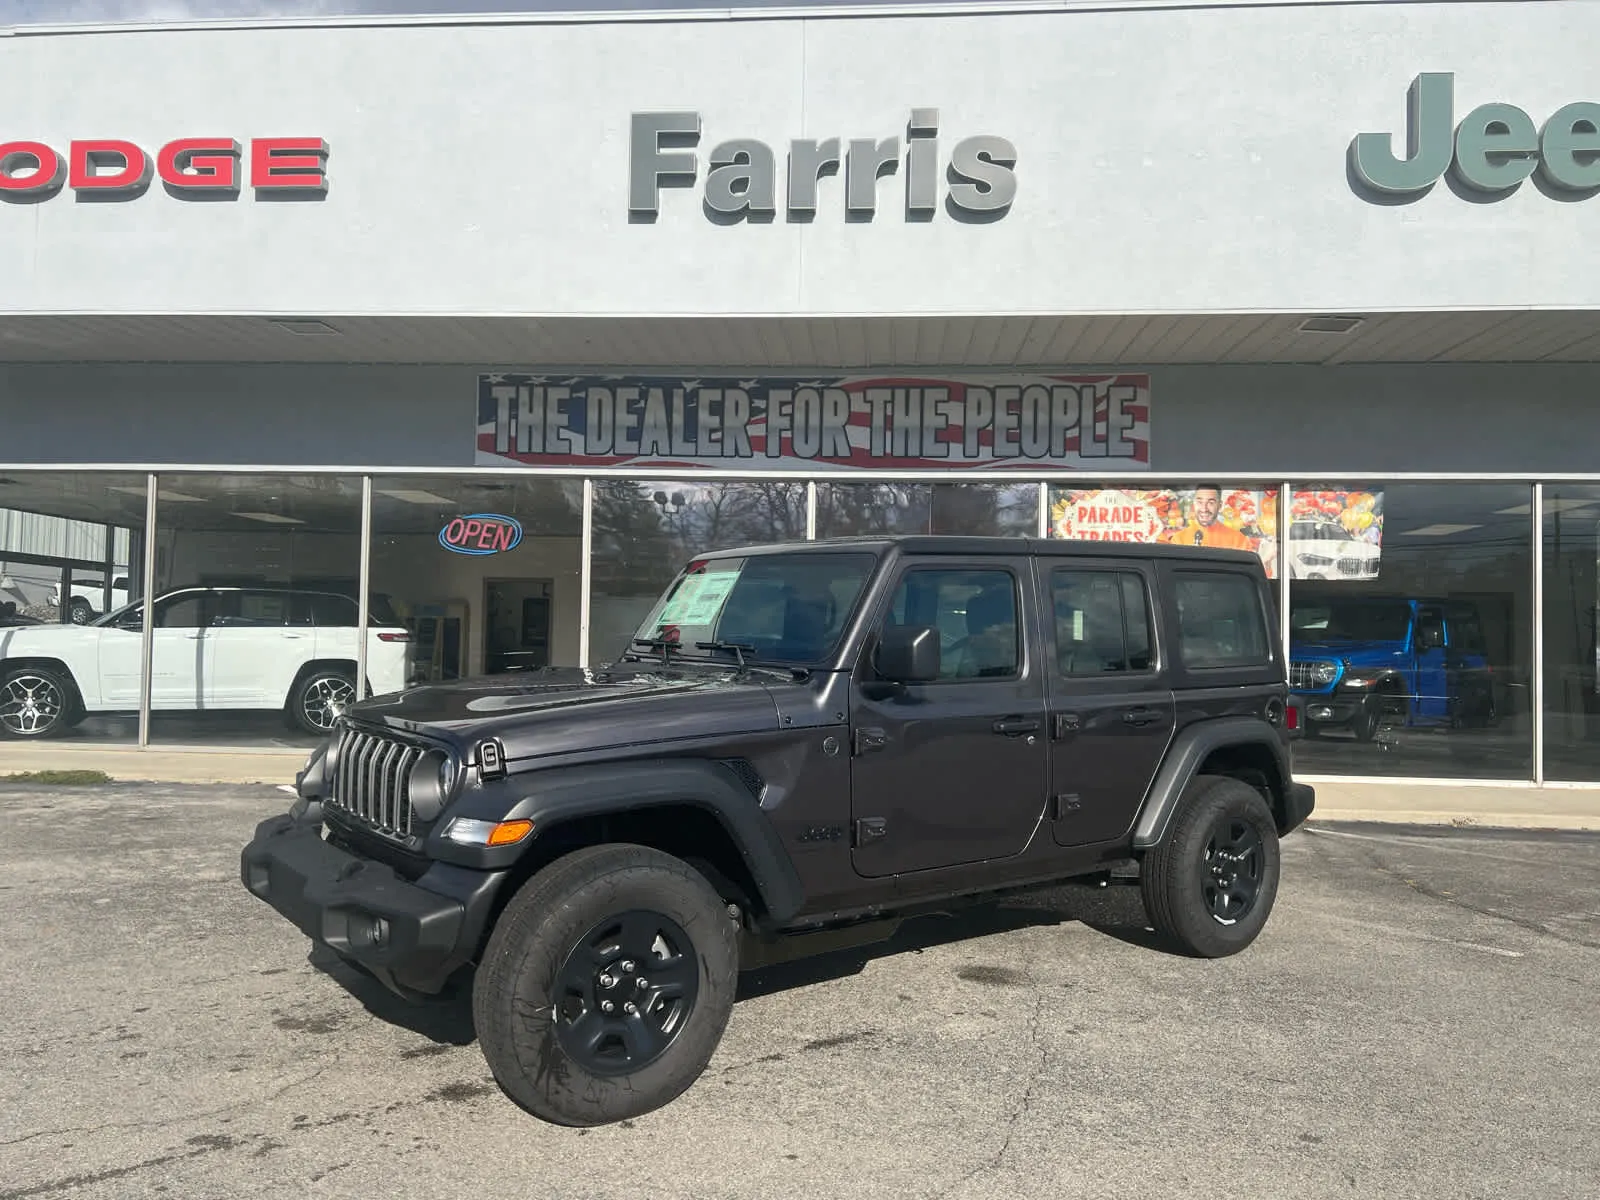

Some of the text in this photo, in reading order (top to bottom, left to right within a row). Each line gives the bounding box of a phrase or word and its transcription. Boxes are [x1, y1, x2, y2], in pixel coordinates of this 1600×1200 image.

[628, 108, 1019, 225] Farris
[492, 384, 1137, 458] THE DEALER FOR THE PEOPLE
[1077, 506, 1144, 524] PARADE
[446, 518, 514, 552] OPEN
[1077, 530, 1144, 542] TRADES
